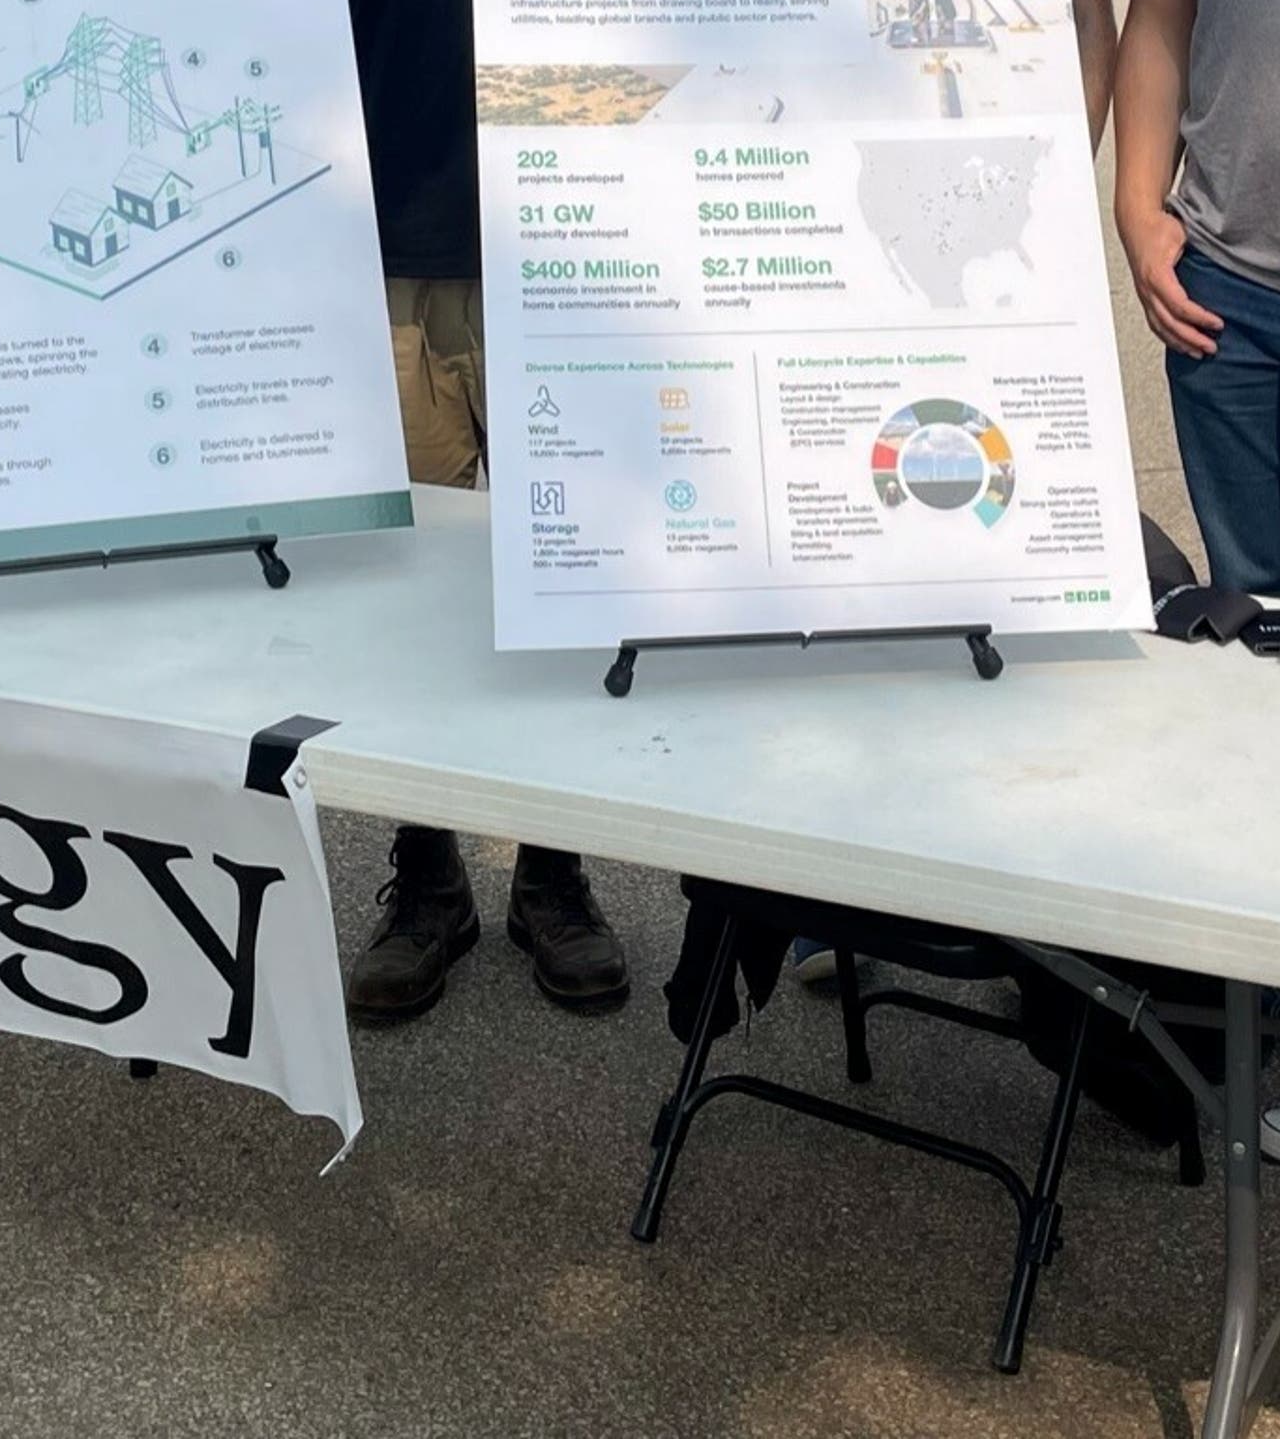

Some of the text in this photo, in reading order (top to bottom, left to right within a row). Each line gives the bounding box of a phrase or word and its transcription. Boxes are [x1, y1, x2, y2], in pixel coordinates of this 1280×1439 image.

[188, 52, 199, 66] 4
[249, 62, 262, 76] 5
[517, 150, 559, 169] 202
[694, 147, 810, 166] 9.4 Million
[517, 172, 624, 185] projects developed
[696, 170, 784, 183] homes powered
[519, 204, 595, 223] 31 GW
[698, 201, 817, 222] $50 Billion
[520, 226, 629, 240] capacity developed
[222, 252, 235, 266] 6
[702, 257, 833, 278] $2.7 Million
[521, 259, 661, 281] $400 Million
[147, 338, 160, 355] 4
[152, 392, 166, 409] 5
[528, 424, 559, 436] Wind
[157, 447, 171, 464] 6
[531, 522, 580, 536] Storage
